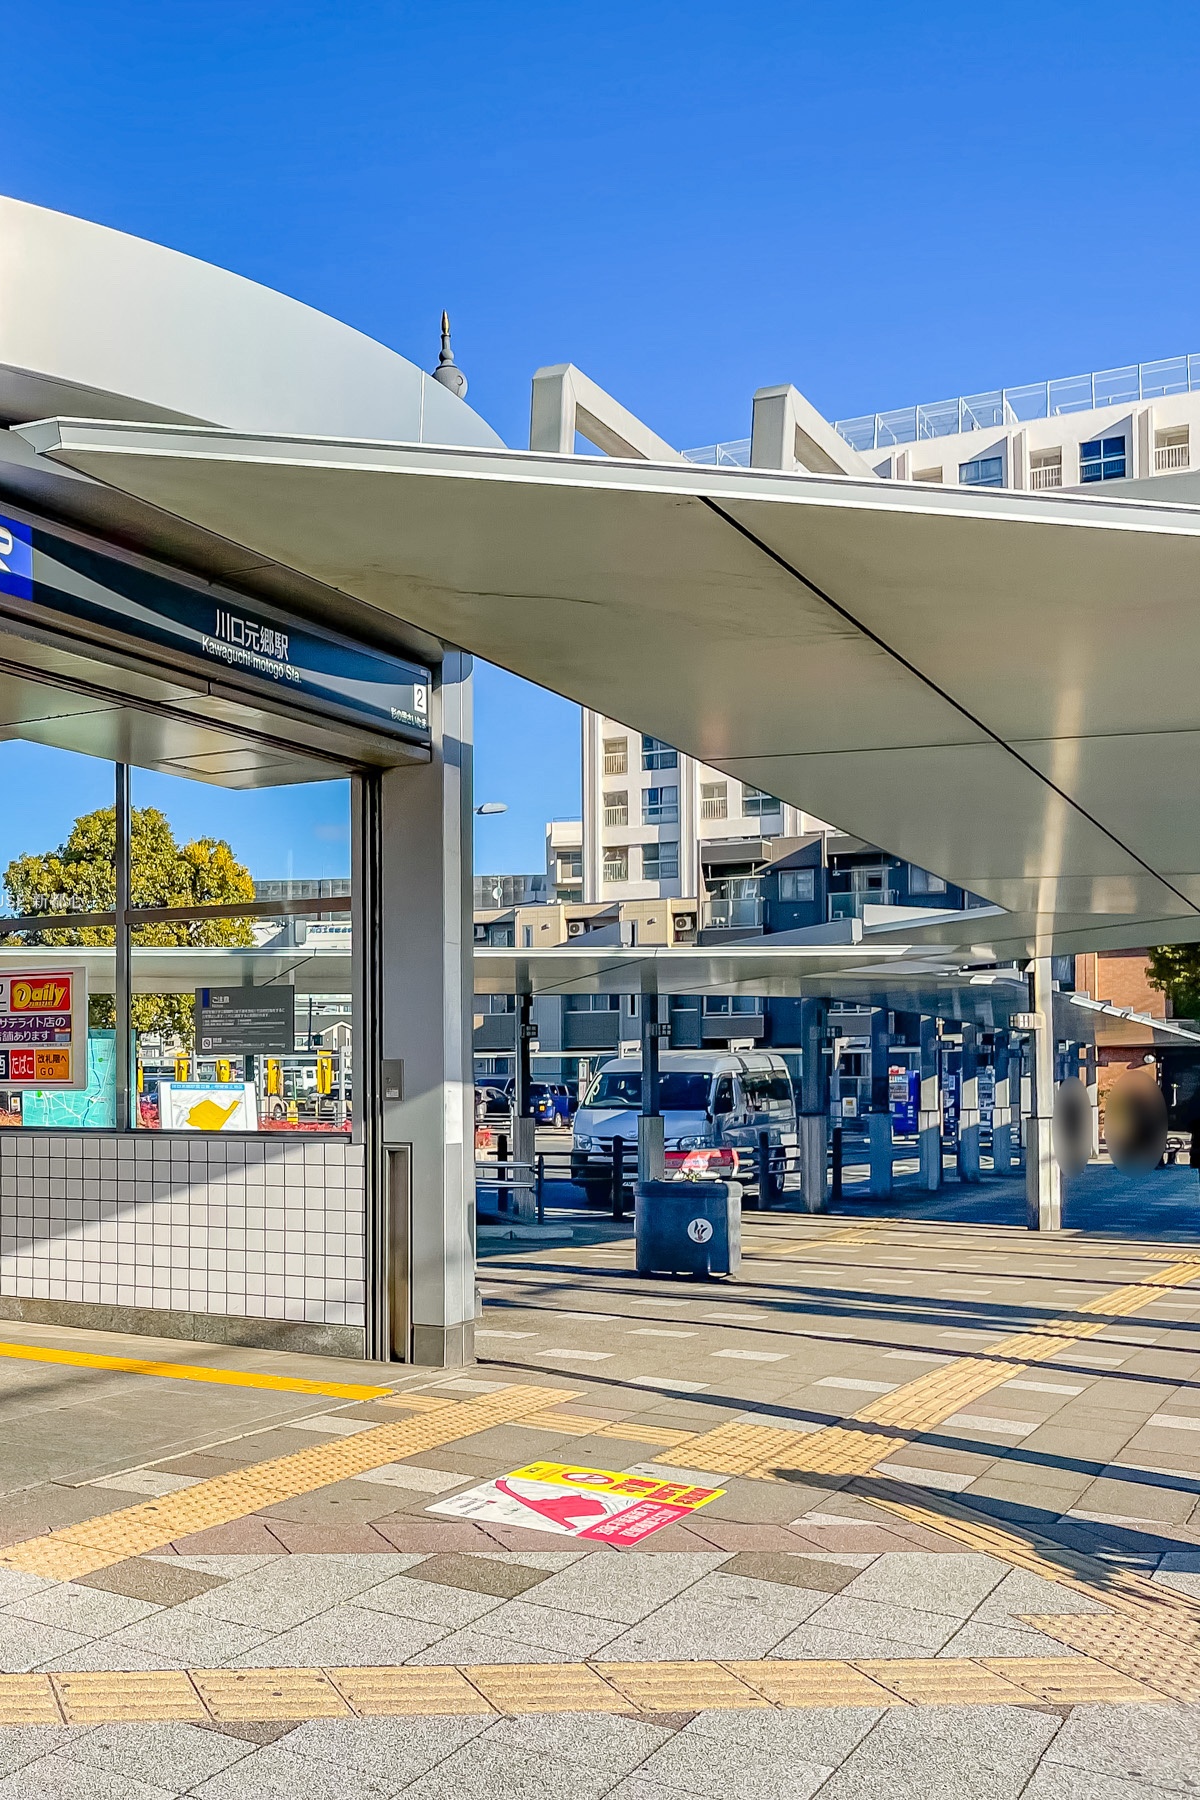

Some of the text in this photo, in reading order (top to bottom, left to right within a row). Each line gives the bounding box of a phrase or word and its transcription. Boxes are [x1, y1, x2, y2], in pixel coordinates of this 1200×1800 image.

[215, 609, 289, 661] 川口元郷駅
[285, 664, 302, 684] Sta.
[416, 687, 424, 708] 2
[12, 982, 66, 1008] Daily
[11, 1055, 34, 1075] たばこ
[37, 1054, 67, 1064] 改札階へ
[40, 1067, 54, 1076] GO
